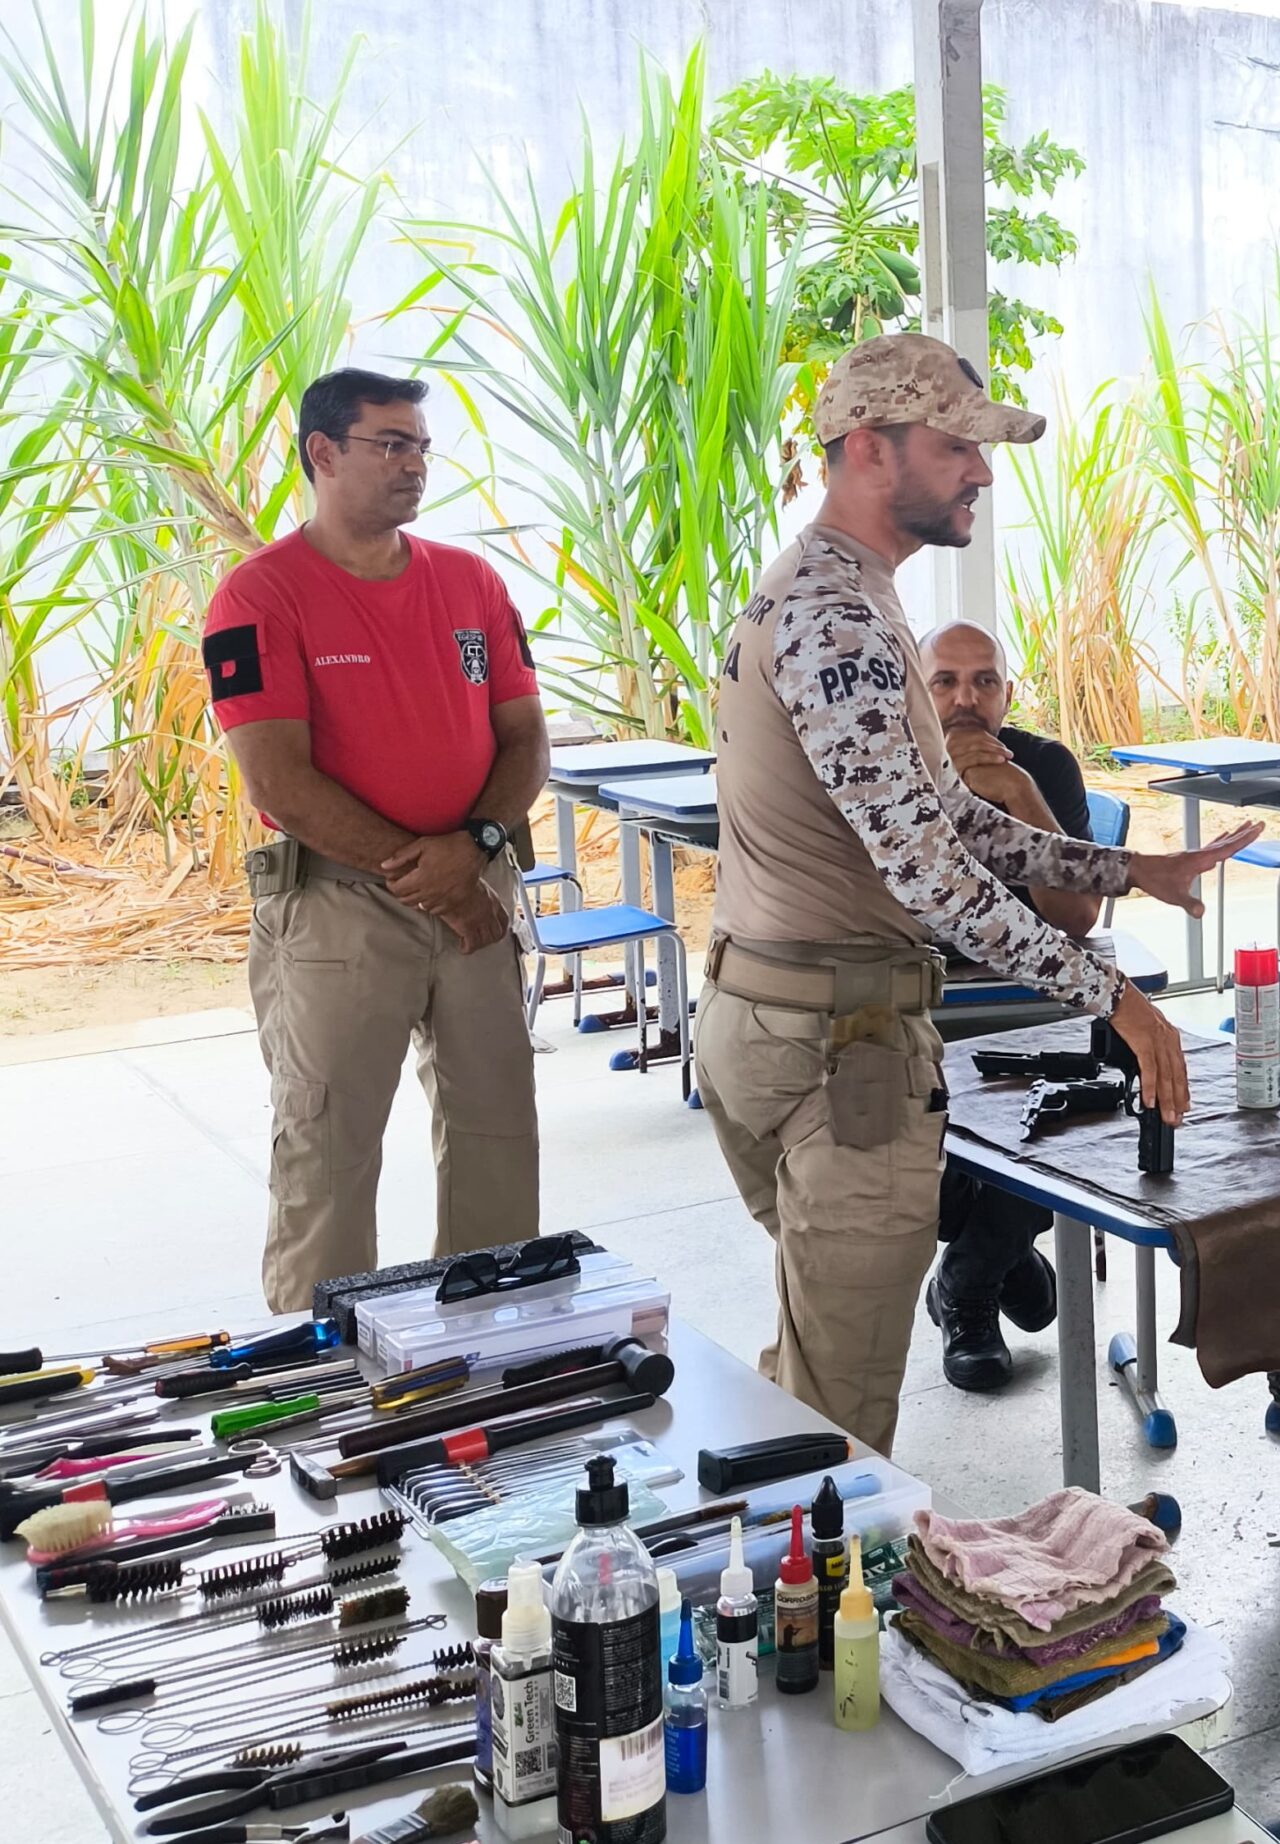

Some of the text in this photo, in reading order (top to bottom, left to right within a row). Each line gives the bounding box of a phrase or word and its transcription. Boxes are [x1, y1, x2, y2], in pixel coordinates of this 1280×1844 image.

[314, 654, 371, 667] ALEXANDRO
[523, 1681, 535, 1744] Green Tech
